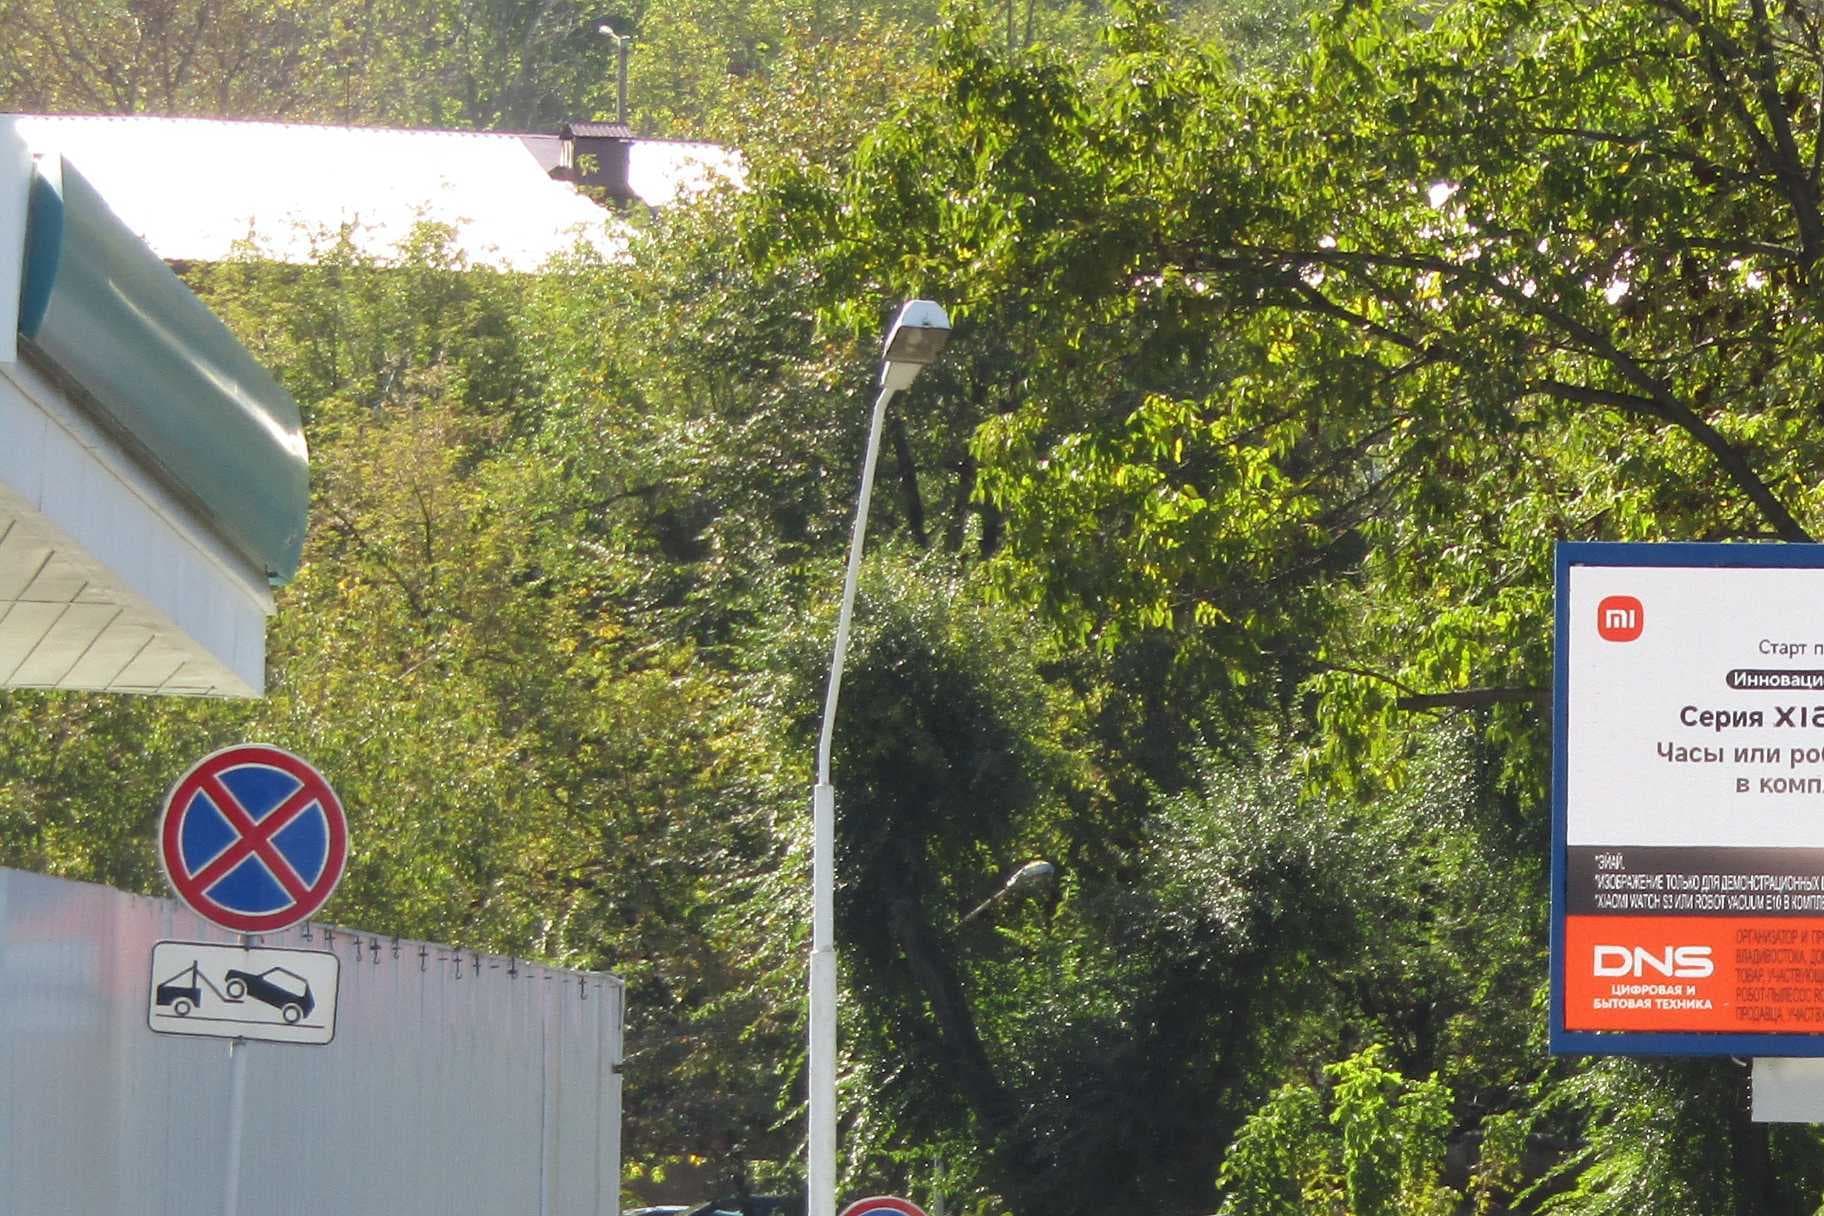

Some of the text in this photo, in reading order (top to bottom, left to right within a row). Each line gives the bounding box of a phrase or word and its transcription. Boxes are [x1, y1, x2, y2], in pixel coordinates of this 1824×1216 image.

[1759, 639, 1807, 657] Старт
[1680, 705, 1763, 732] Серия
[1657, 741, 1724, 763] Часы
[1734, 746, 1780, 764] или
[1736, 777, 1750, 793] в
[1666, 874, 1700, 890] ТОЛЬКО
[1701, 874, 1720, 892] ДЛЯ
[1721, 874, 1820, 892] ДЕМОНСТРАЦИОННЫХ
[1630, 893, 1661, 909] WATCH
[1663, 893, 1673, 910] S3
[1675, 893, 1693, 910] ИЛИ
[1695, 893, 1726, 910] ROBOT
[1727, 894, 1766, 911] VACUUM
[1766, 894, 1782, 911] E10
[1783, 895, 1790, 911] В
[1592, 944, 1715, 978] DNS
[1611, 984, 1696, 996] ЦИФРОВАЯ И
[1592, 998, 1713, 1010] БЫТОВАЯ ТЕХНИКА
